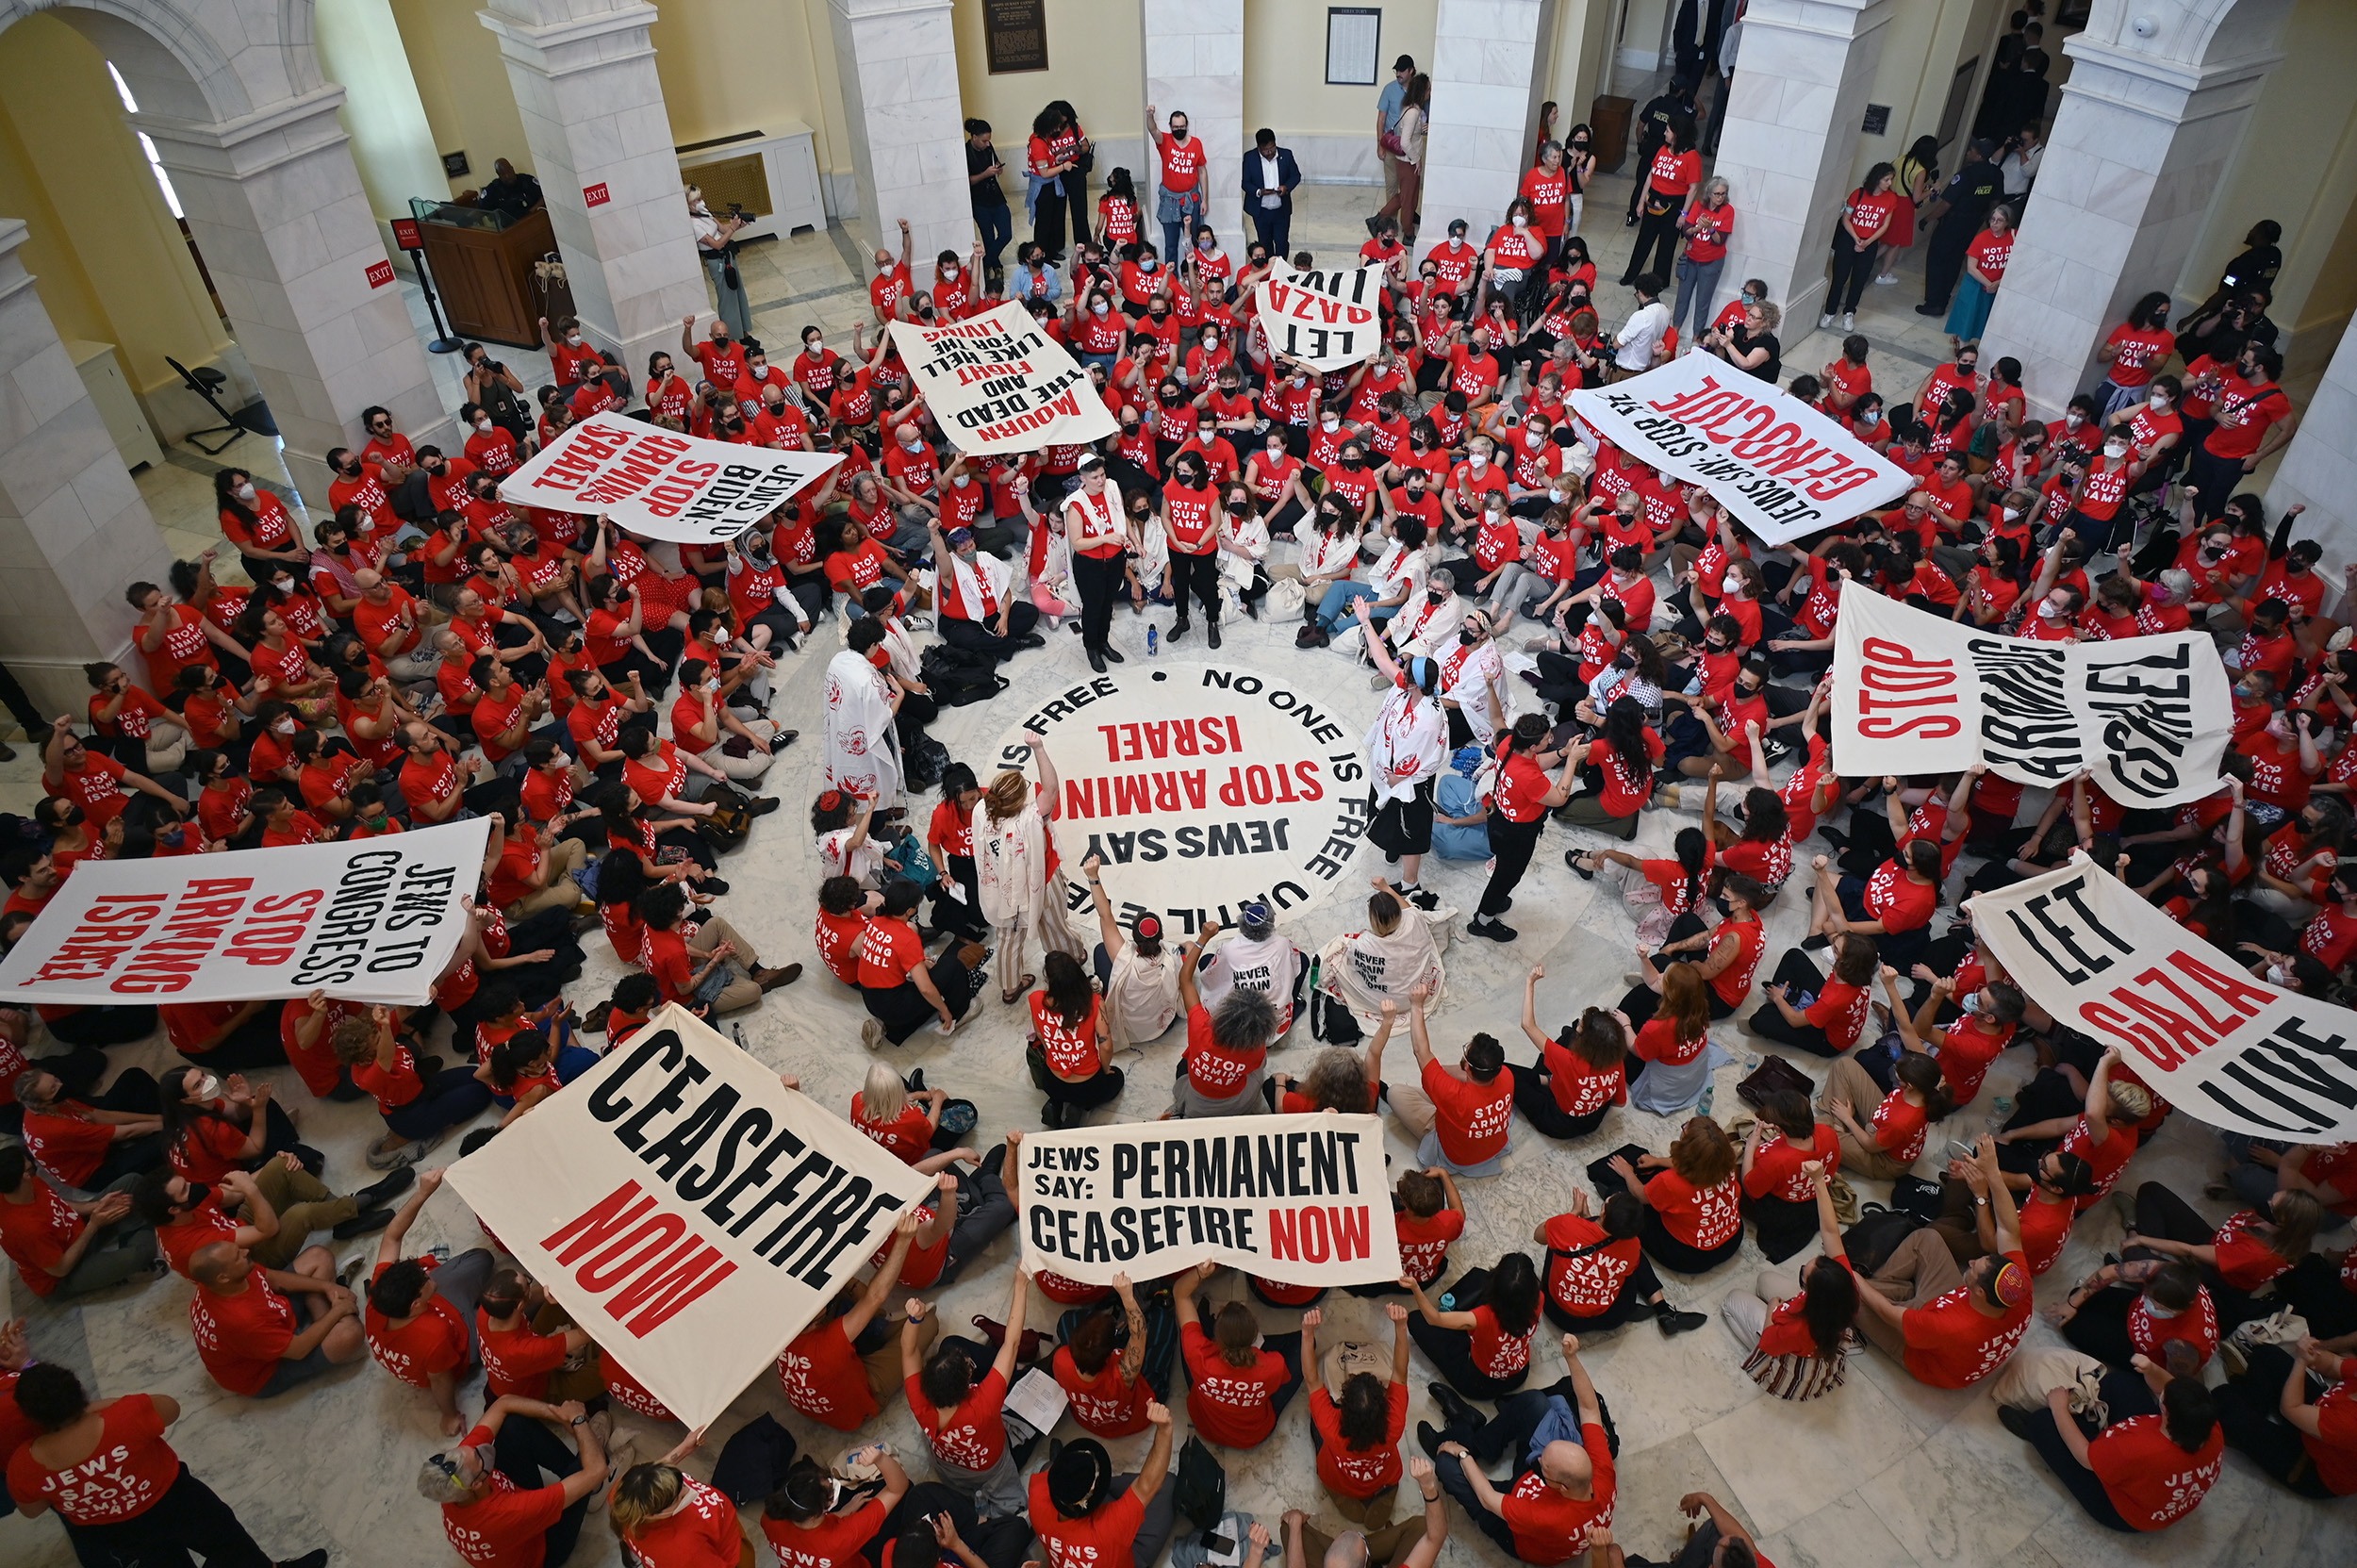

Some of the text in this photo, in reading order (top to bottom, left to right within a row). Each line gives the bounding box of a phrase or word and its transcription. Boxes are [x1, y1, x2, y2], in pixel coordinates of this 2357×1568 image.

[1171, 148, 1185, 158] NOT
[1172, 157, 1192, 167] OUR
[1657, 155, 1672, 163] NOT
[1168, 162, 1195, 173] NAME
[1651, 166, 1676, 180] NAME
[1656, 161, 1673, 171] OUR
[586, 188, 606, 203] EXIT
[1534, 196, 1563, 205] NAME
[1539, 189, 1560, 197] OUR
[1853, 217, 1879, 229] NAME
[1856, 211, 1879, 221] OUR
[1497, 247, 1526, 257] NAME
[1503, 241, 1525, 250] OUR
[369, 266, 389, 283] EXIT
[1139, 278, 1159, 288] OUR
[1269, 279, 1372, 323] GAZA
[922, 319, 1004, 342] LIVING
[1095, 334, 1116, 344] OUR
[1111, 329, 1118, 338] IN
[1280, 323, 1354, 359] LET
[920, 332, 1044, 377] LIKE HELL
[931, 334, 1014, 355] FOR THE
[807, 366, 832, 377] STOP
[956, 360, 1033, 387] FIGHT
[981, 375, 1028, 398] AND
[1455, 377, 1480, 396] NAME
[948, 370, 1085, 428] THE DEAD,
[2226, 392, 2244, 405] NOT
[977, 388, 1081, 441] MOURN
[1634, 417, 1708, 457] STOP
[1647, 375, 1879, 502] GENOCIDE
[532, 424, 638, 490] ISRAEL
[1689, 453, 1755, 482] SAY:
[575, 435, 692, 504] ARMING
[1607, 468, 1631, 488] STOP
[2089, 473, 2127, 486] NOT IN
[351, 478, 375, 503] NOT IN
[638, 459, 719, 518] STOP
[679, 464, 763, 525] BIDEN:
[1334, 481, 1365, 492] NOT IN
[2090, 481, 2121, 494] OUR
[360, 489, 381, 508] OUR
[709, 464, 804, 536] JEWS TO
[1170, 500, 1192, 509] NOT
[1645, 495, 1675, 514] NOT IN
[1736, 479, 1821, 525] JEWS
[272, 506, 279, 515] IN
[1172, 509, 1199, 520] OUR
[1646, 505, 1669, 520] OUR
[261, 517, 283, 533] OUR
[805, 527, 812, 537] IN
[799, 537, 816, 556] OUR
[1476, 539, 1496, 554] OUR
[1480, 526, 1505, 550] NOT IN
[852, 553, 874, 570] STOP
[1537, 554, 1553, 570] OUR
[1550, 555, 1560, 566] IN
[2087, 618, 2113, 639] STOP
[2144, 603, 2165, 632] STOP
[167, 623, 194, 642] STOP
[170, 630, 204, 652] ARMING
[1202, 668, 1263, 695] NO
[1858, 636, 1961, 739] STOP
[598, 706, 617, 734] STOP
[1268, 690, 1343, 745] ONE
[1967, 638, 2083, 780] ARMING
[997, 676, 1120, 771] IS FREE
[2085, 643, 2193, 798] ISRAEL
[1097, 716, 1244, 763] ISRAEL
[1328, 751, 1362, 782] IS
[432, 773, 448, 794] NOT
[667, 770, 683, 791] NOT
[1050, 760, 1324, 822] STOP ARMIN
[1080, 817, 1291, 867] JEWS SAY
[1303, 797, 1367, 882] FREE
[221, 889, 324, 966] STOP
[290, 850, 403, 985] CONGRESS
[367, 863, 456, 973] JEWS TO
[18, 894, 168, 986] ISRAEL
[109, 877, 255, 993] ARMING
[2005, 876, 2135, 986] LET
[1354, 949, 1385, 966] NEVER
[1355, 959, 1385, 975] AGAIN
[1233, 966, 1270, 981] NEVER
[1234, 980, 1270, 991] AGAIN
[2079, 949, 2280, 1073] GAZA
[1045, 1025, 1080, 1041] SAY
[1045, 1039, 1086, 1052] STOP
[1201, 1051, 1246, 1073] STOP
[1475, 1094, 1512, 1118] STOP
[587, 1028, 907, 1292] CEASEFIRE
[1028, 1146, 1100, 1171] JEWS
[1112, 1131, 1360, 1199] PERMANENT
[1034, 1173, 1094, 1199] SAY:
[1701, 1190, 1735, 1216] SAY
[1030, 1205, 1371, 1263] CEASEFIRE NOW
[539, 1179, 739, 1340] NOW
[1572, 1258, 1618, 1279] SAY
[1566, 1270, 1619, 1289] STOP
[1978, 1314, 2033, 1353] JEWS
[368, 1334, 411, 1365] JEWS
[612, 1382, 662, 1407] STOP
[1199, 1383, 1266, 1399] ARMING
[1207, 1377, 1264, 1392] STOP
[1071, 1393, 1120, 1410] JEWS
[1077, 1405, 1115, 1420] SAY
[41, 1444, 129, 1494] JEWS
[2165, 1452, 2223, 1487] JEWS
[59, 1466, 124, 1501] SAY
[62, 1476, 136, 1506] STOP
